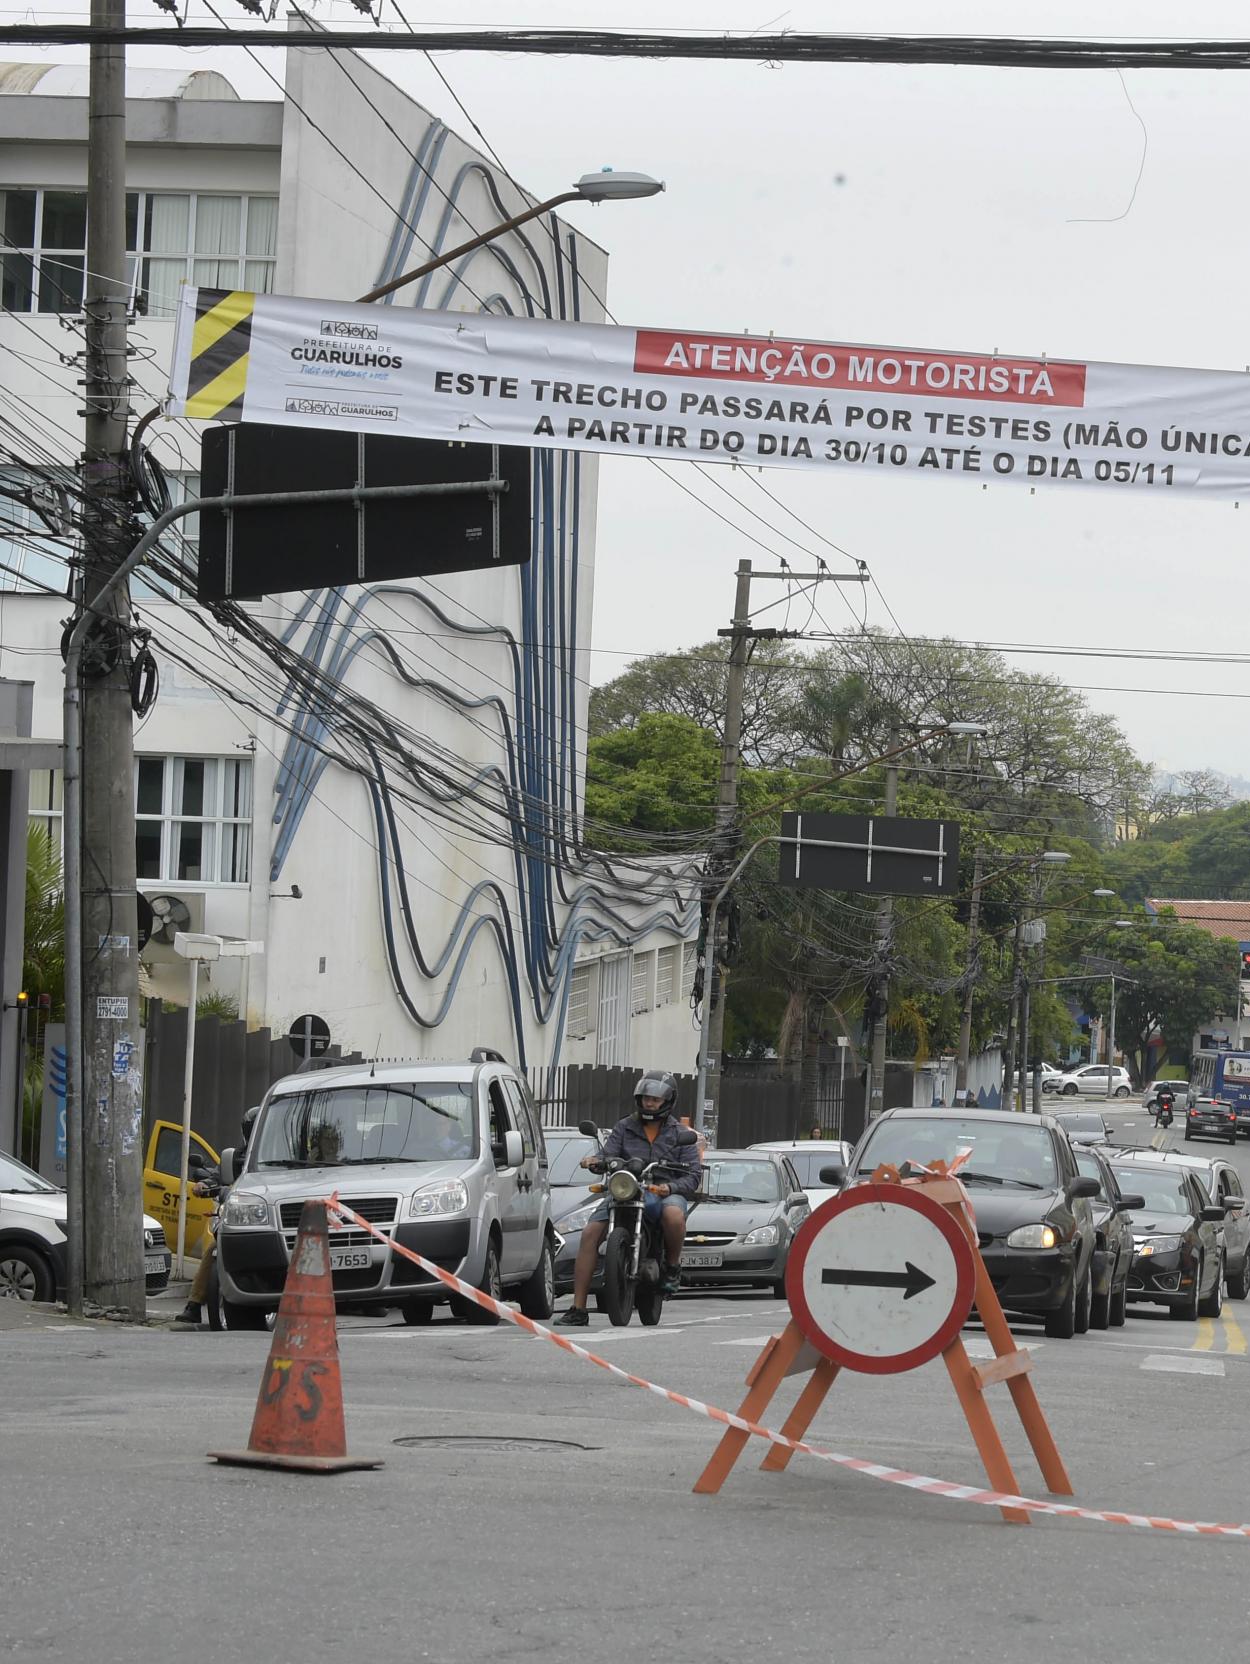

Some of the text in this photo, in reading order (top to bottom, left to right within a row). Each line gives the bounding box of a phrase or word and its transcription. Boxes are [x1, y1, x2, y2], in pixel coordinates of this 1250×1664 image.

[303, 338, 392, 353] PREFEITURA DE
[290, 347, 403, 369] GUARULHOS
[663, 341, 1056, 397] ATENÇÃO MOTORISTA
[341, 406, 394, 418] GUARULHOS
[434, 371, 519, 400] ESTE
[530, 379, 668, 412] TRECHO
[679, 391, 833, 426] PASSARÁ
[845, 406, 912, 432] POR
[924, 412, 1051, 442] TESTES
[1063, 420, 1148, 450] (MÃO
[533, 415, 1174, 486] A PARTIR DO DIA 30/10 ATÉ O DIA 05/11
[162, 1192, 191, 1208] ST
